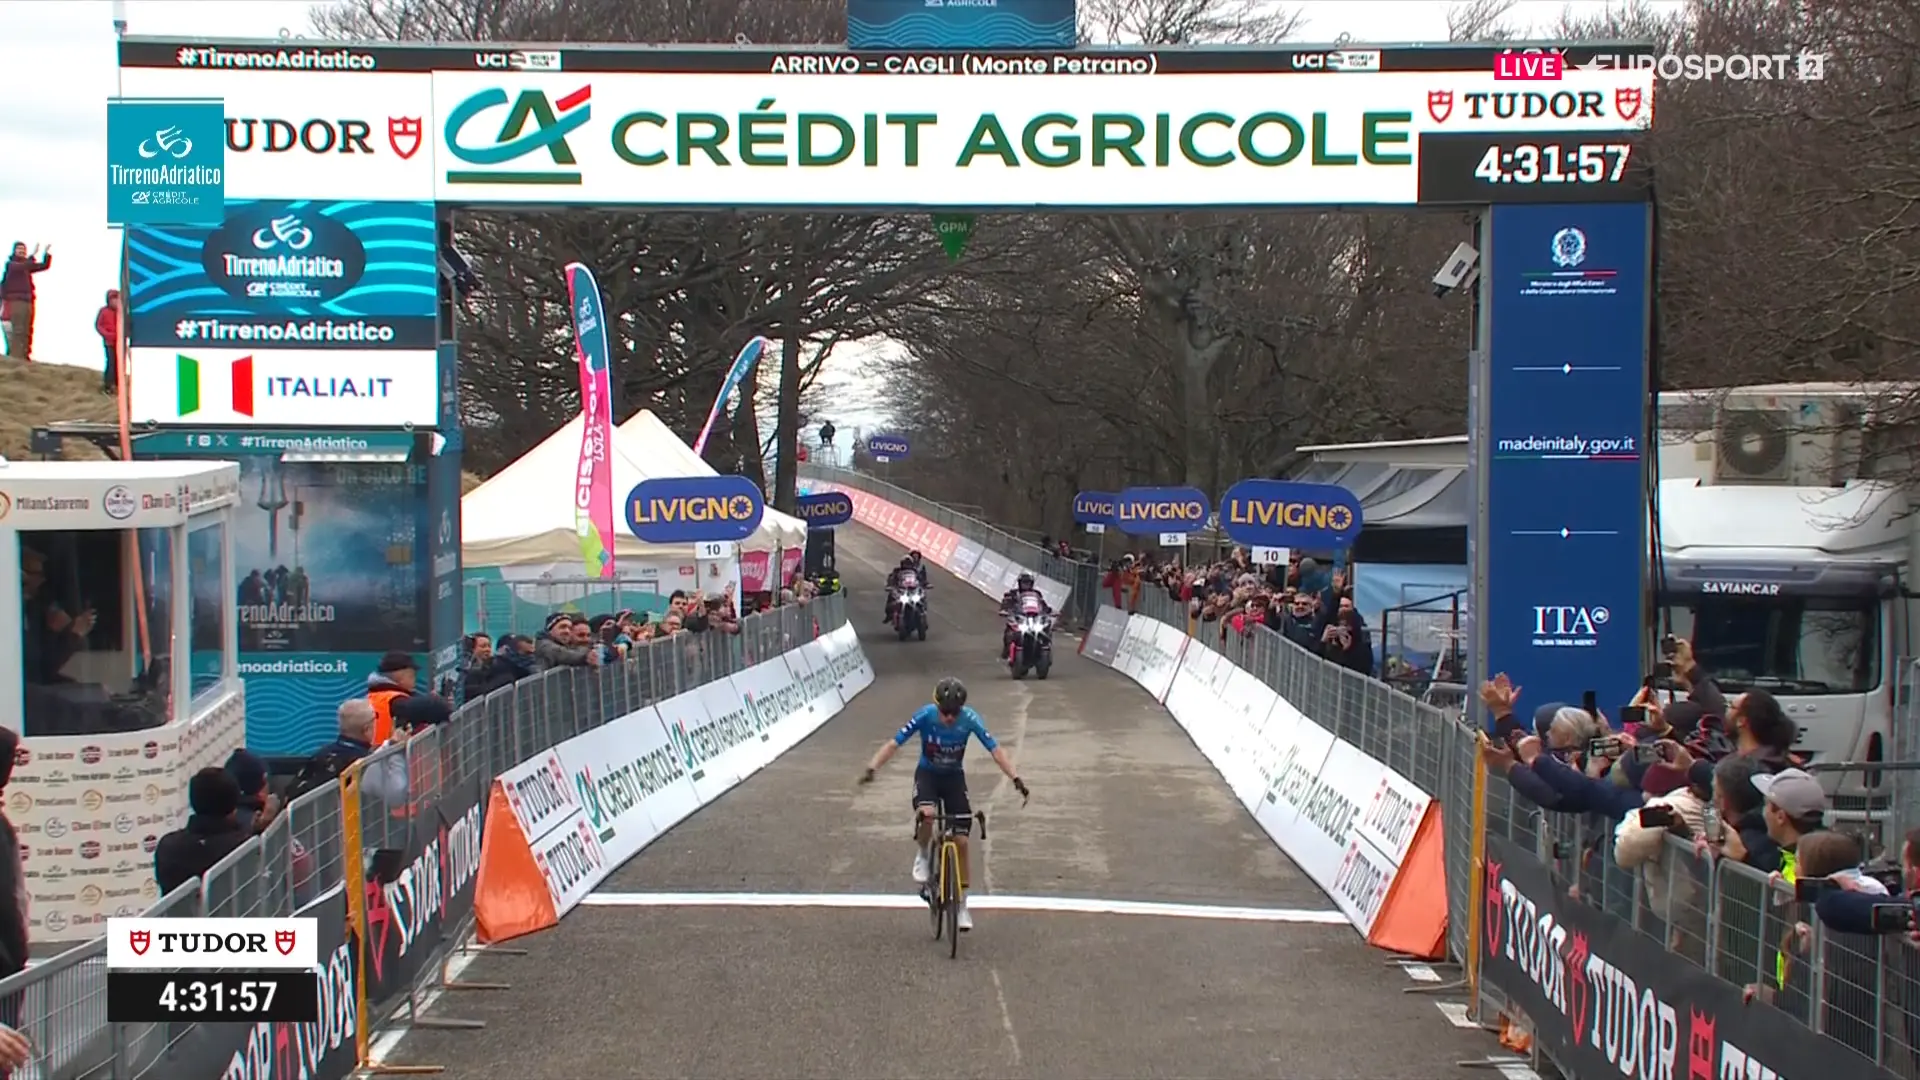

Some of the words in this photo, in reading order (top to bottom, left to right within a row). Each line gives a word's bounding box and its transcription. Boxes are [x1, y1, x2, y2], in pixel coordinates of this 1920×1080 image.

[177, 48, 375, 69] #TirrenoAdriatico
[475, 53, 507, 67] UCI
[771, 56, 860, 73] ARRIVO
[884, 56, 954, 73] CAGLI
[962, 54, 1048, 74] (Monte
[1053, 54, 1157, 74] Petrano)
[1292, 54, 1324, 68] UCI
[1464, 91, 1605, 119] TUDOR
[224, 118, 374, 154] UDOR
[611, 98, 937, 167] CRÉDIT
[955, 112, 1412, 168] AGRICOLE
[1475, 145, 1631, 184] 4:31:57
[940, 221, 967, 233] GPM
[223, 253, 343, 278] TirrenoAdriatico
[175, 319, 394, 342] #TirrenoAdriatico
[267, 377, 392, 397] ITALIA.IT
[241, 435, 367, 450] #TirrenoAdriatico
[1499, 437, 1635, 454] madeinitaly.gov.it
[634, 496, 754, 524] LIVIGNO
[797, 501, 848, 517] IVIGNO
[1077, 501, 1115, 516] LIVIG
[1120, 502, 1203, 519] LIVIGNO
[1231, 499, 1353, 530] LIVIGNO
[706, 544, 721, 556] 10
[1167, 534, 1179, 543] 25
[1263, 550, 1279, 562] 10
[1702, 582, 1779, 596] SAVIANCAR
[237, 601, 335, 622] renoAdriatico
[1532, 606, 1597, 634] ITA
[237, 660, 348, 673] enoadriatico.it
[598, 763, 641, 819] CRÉDIT
[633, 743, 684, 801] AGRICOLE
[516, 766, 564, 824] TUDOR
[1302, 779, 1361, 848] AGRICOLE
[1371, 785, 1413, 846] TUDOR
[449, 803, 480, 898] TUDOR
[546, 831, 594, 892] TUDOR
[1341, 850, 1382, 914] TUDOR
[1501, 878, 1568, 1016] TUDOR
[1586, 952, 1678, 1080] TUDOR
